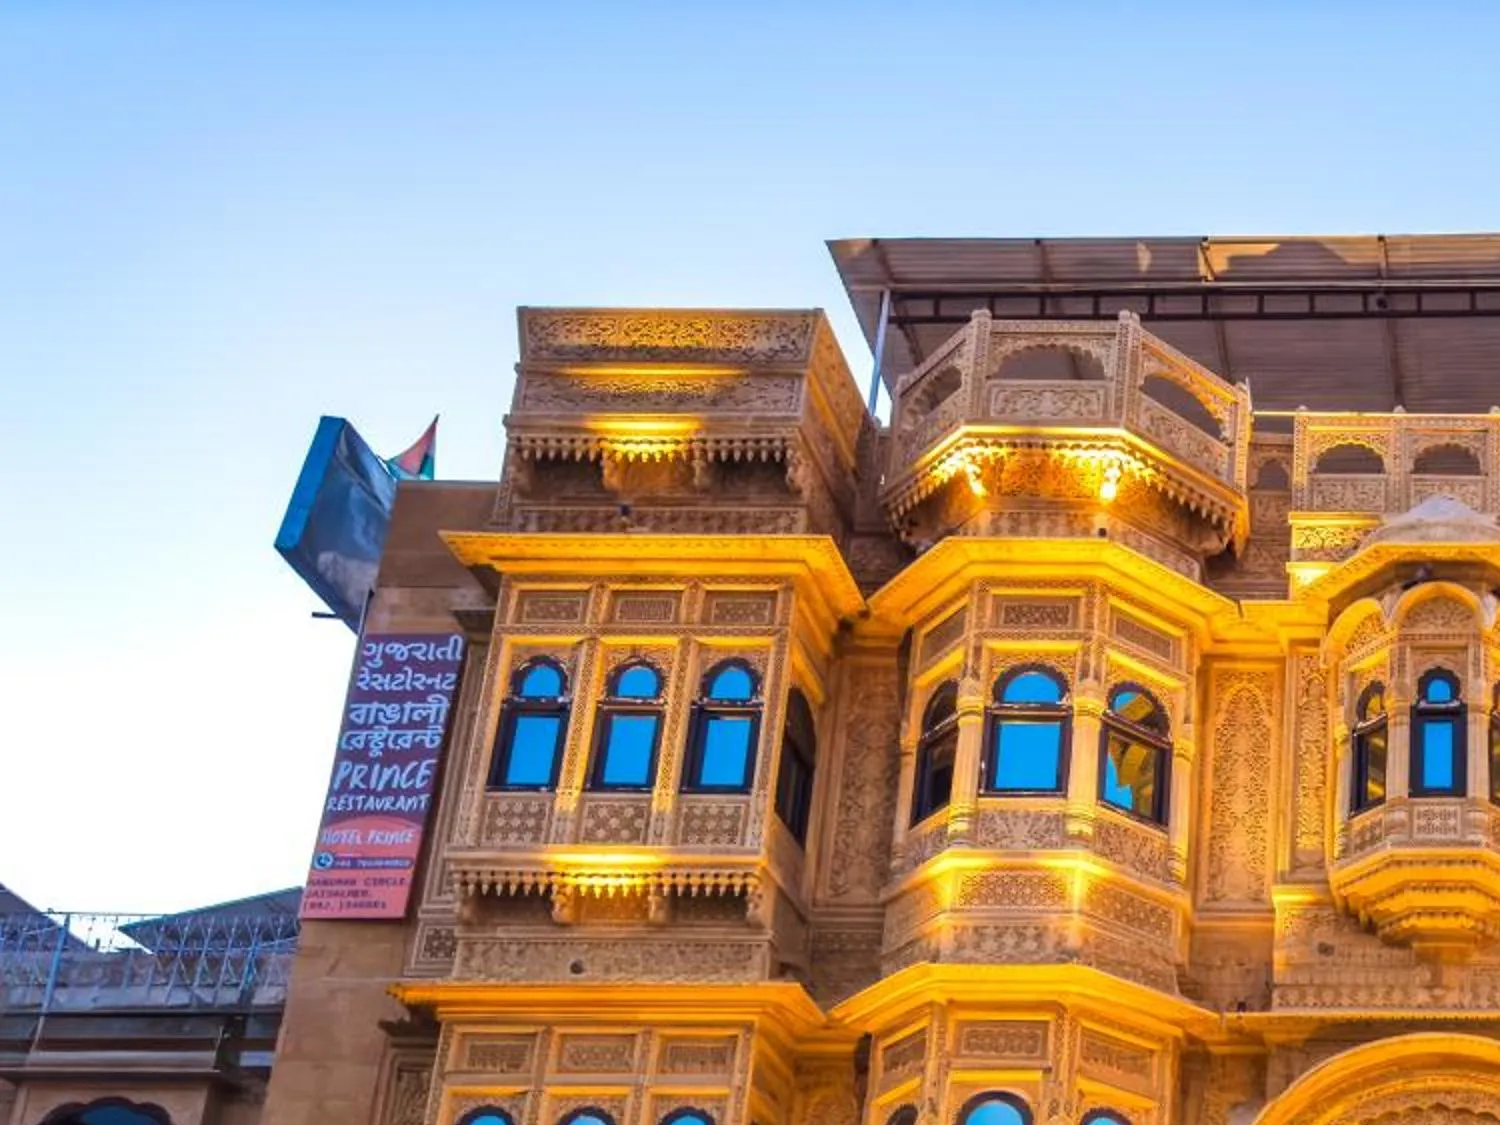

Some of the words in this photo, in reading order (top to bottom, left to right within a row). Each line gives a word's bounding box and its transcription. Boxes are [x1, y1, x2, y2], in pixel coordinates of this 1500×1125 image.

[363, 635, 463, 668] ગુજરાતી
[332, 759, 438, 791] PRINCE
[327, 794, 431, 812] RESTAURANT
